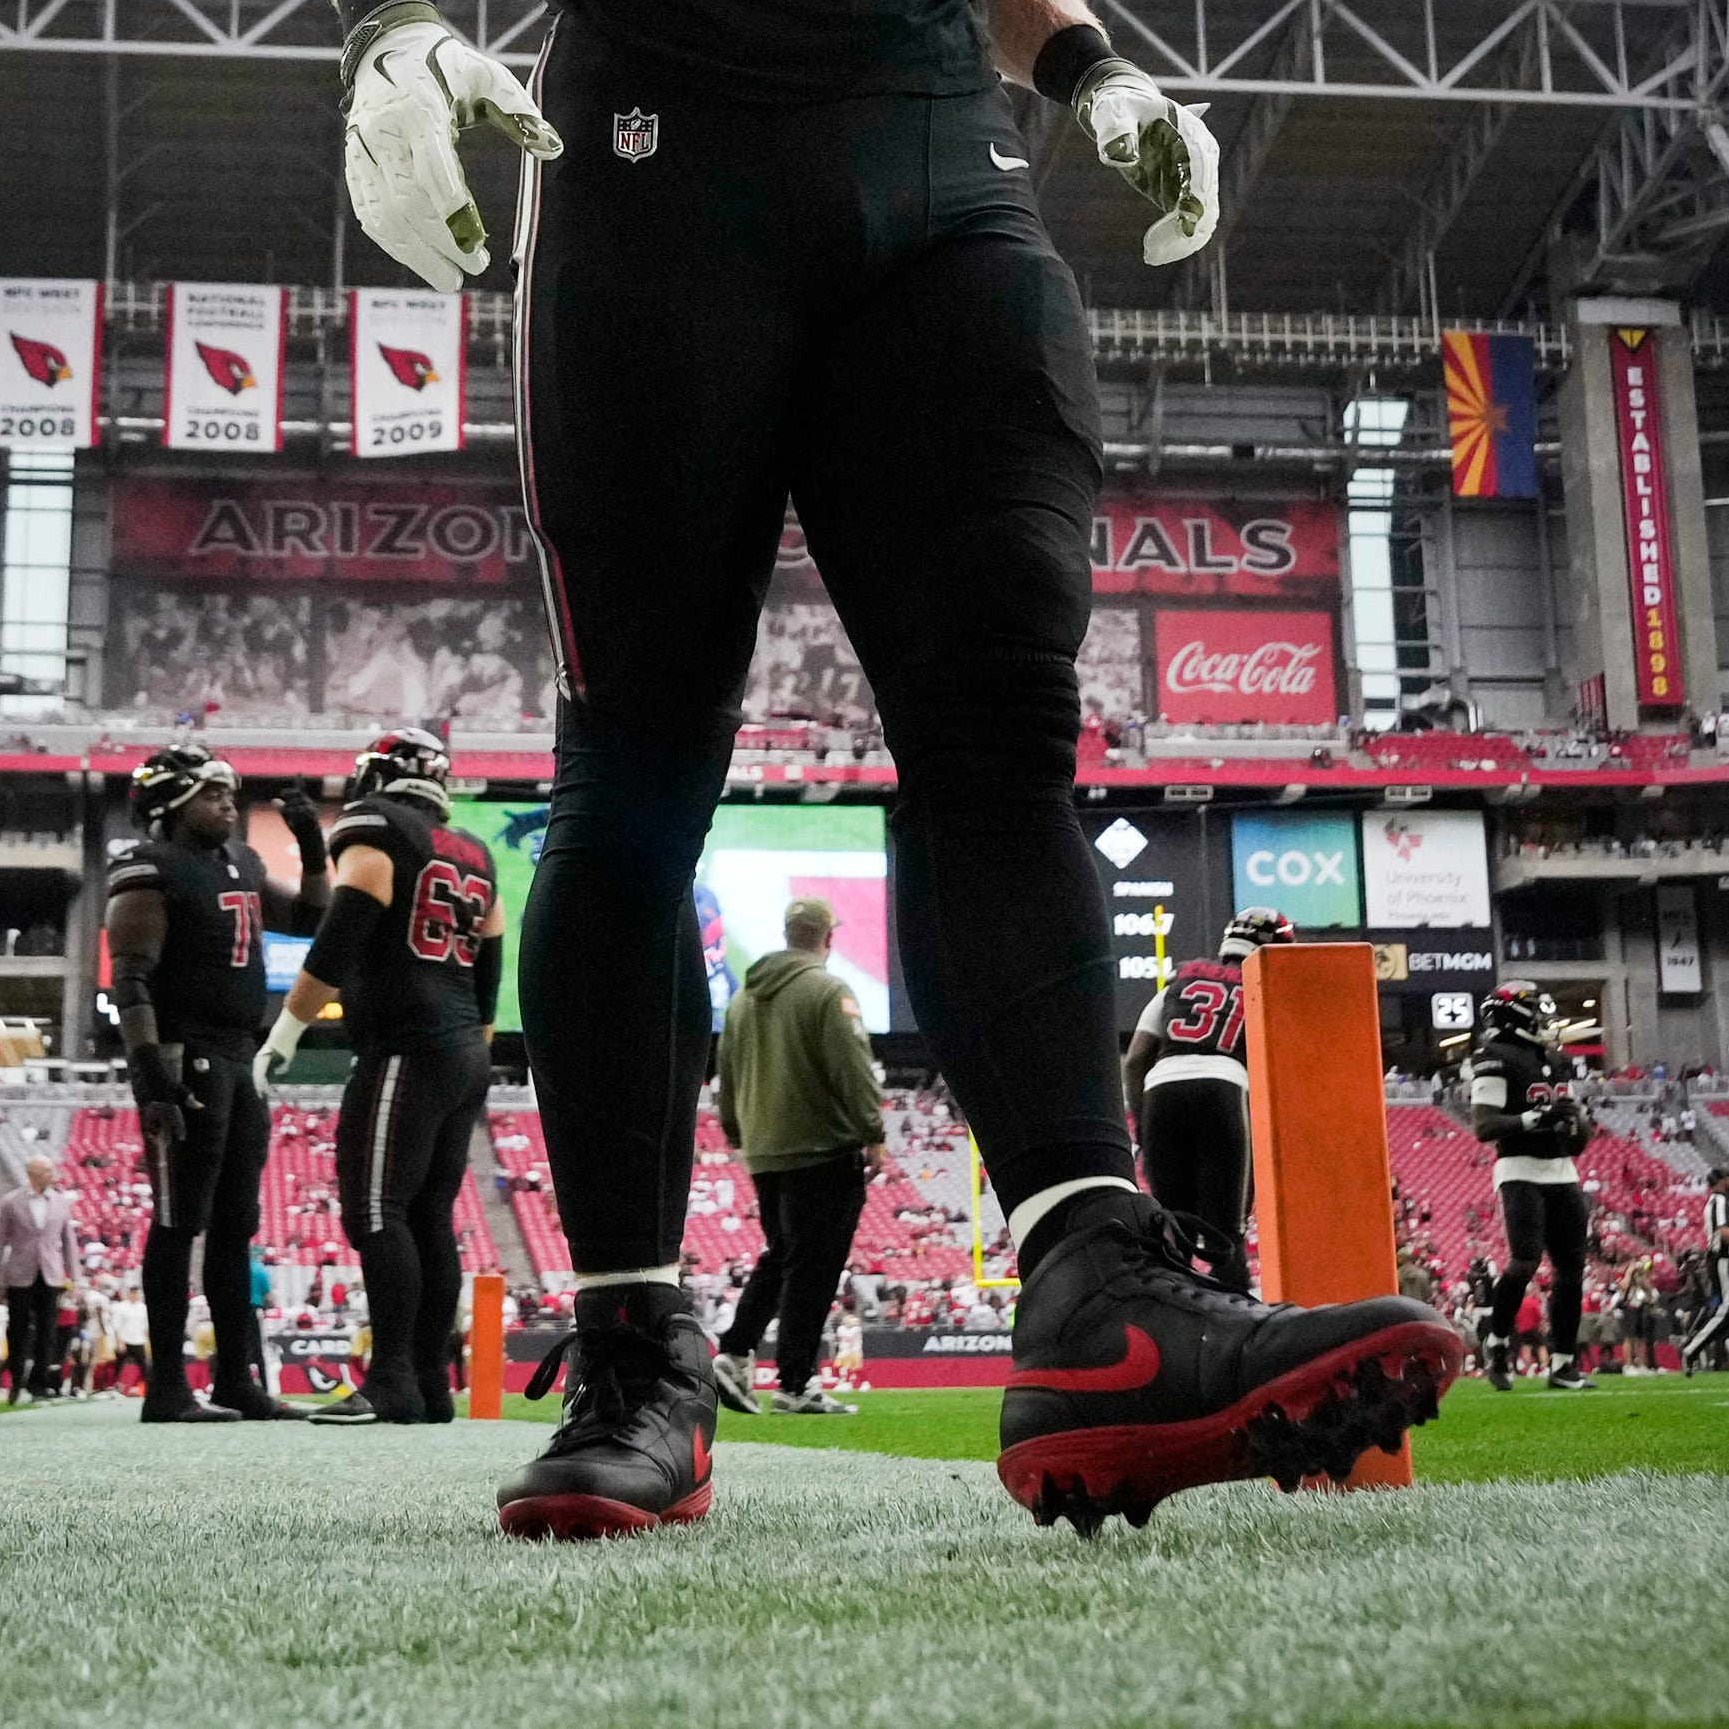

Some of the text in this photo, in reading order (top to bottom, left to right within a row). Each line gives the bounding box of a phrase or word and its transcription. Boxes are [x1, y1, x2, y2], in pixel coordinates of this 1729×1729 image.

[0, 417, 75, 437] 2008
[186, 420, 259, 440] 2008
[372, 421, 442, 446] 2009
[1627, 367, 1662, 606] ESTABLISHED
[1646, 608, 1669, 697] 1898
[1166, 641, 1322, 695] Coca-Cola
[1246, 850, 1345, 887] COX
[1385, 871, 1463, 887] University
[1387, 890, 1467, 904] of Phoenix
[409, 859, 492, 967] 63
[1408, 952, 1492, 971] BETMGM
[1167, 980, 1245, 1053] 31
[1437, 997, 1470, 1024] 25
